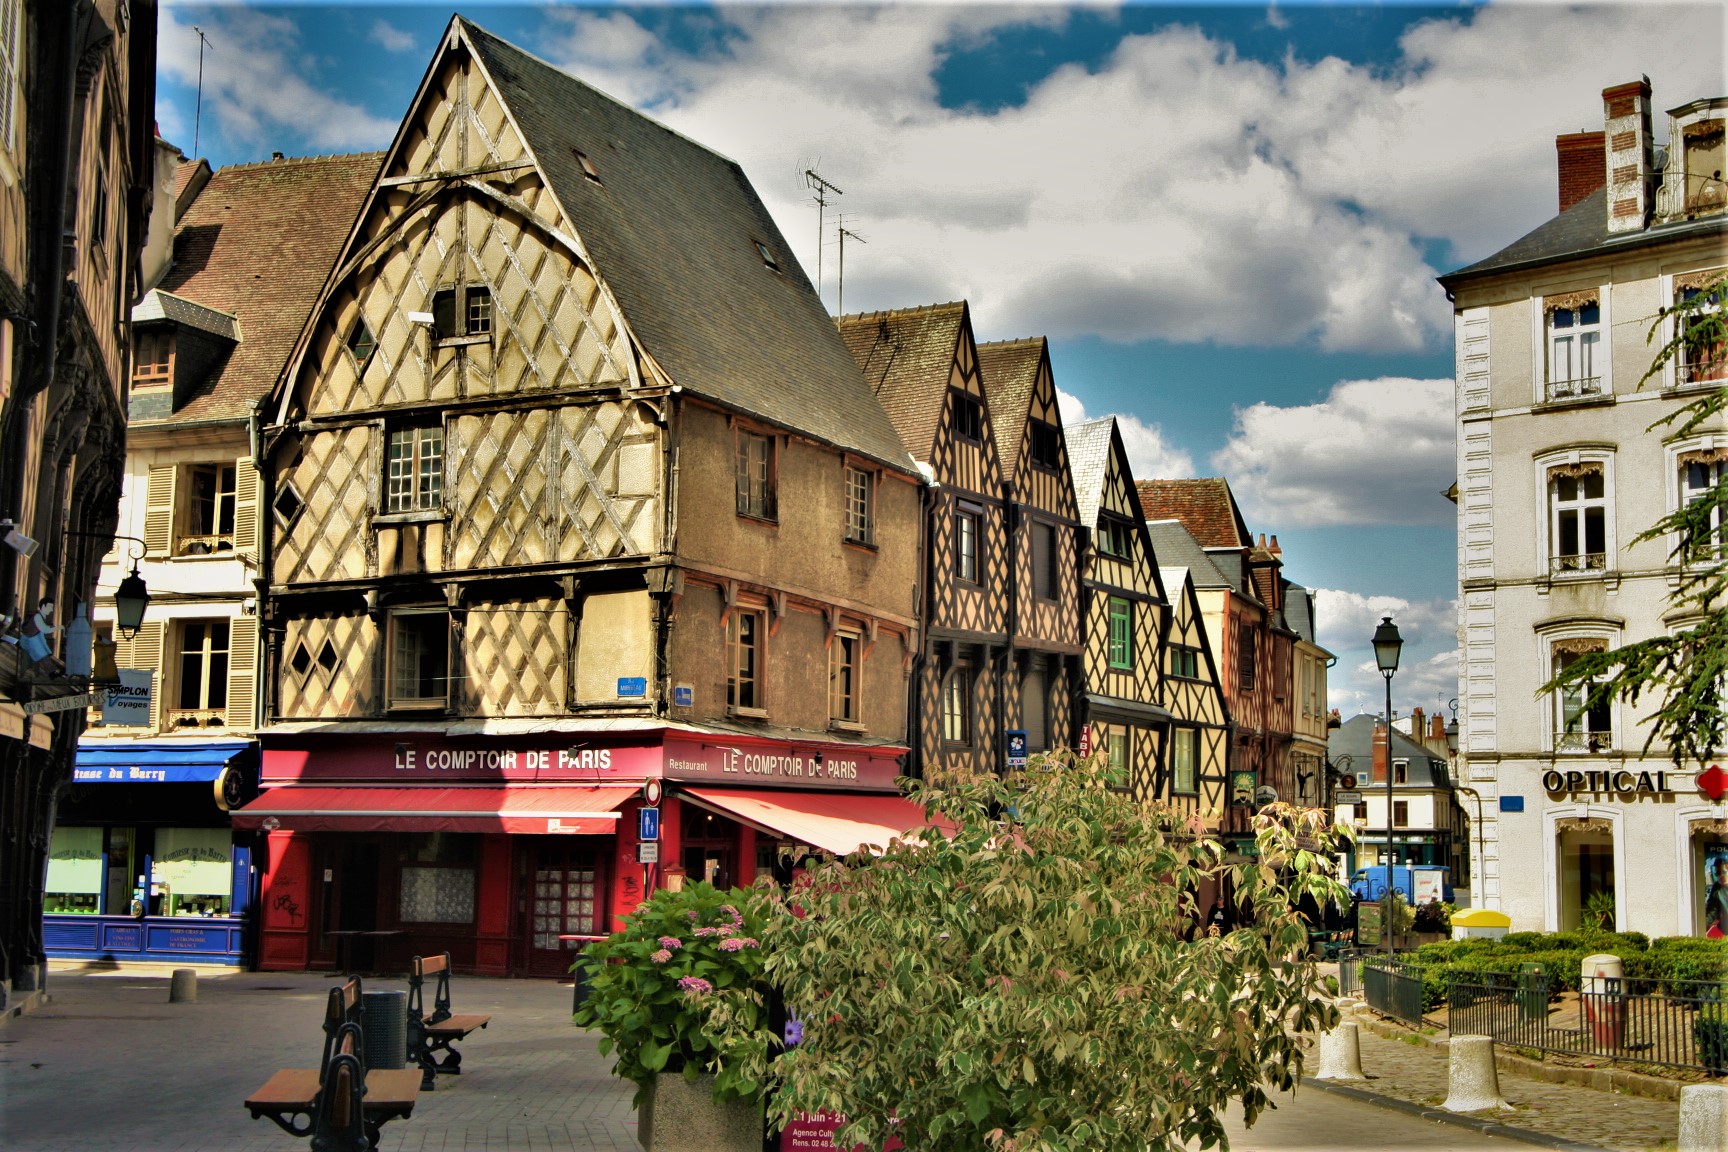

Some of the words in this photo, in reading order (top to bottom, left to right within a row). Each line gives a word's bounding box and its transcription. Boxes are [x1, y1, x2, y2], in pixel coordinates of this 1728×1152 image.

[395, 750, 416, 770] LE
[425, 749, 518, 771] COMPTOIR
[526, 750, 550, 770] DE
[558, 749, 611, 771] PARIS
[669, 758, 708, 772] Restaurant
[723, 752, 738, 772] LE
[744, 754, 803, 777] COMPTOIR
[808, 757, 823, 778] DE
[828, 760, 857, 780] PARIS
[74, 768, 103, 779] tesse
[108, 767, 123, 779] du
[129, 766, 166, 781] Barry
[1543, 770, 1672, 793] OPTICAL
[807, 1111, 826, 1124] juin
[835, 1113, 846, 1123] 21
[792, 1128, 817, 1139] Agence
[792, 1138, 810, 1147] Rens.
[811, 1139, 819, 1147] 02
[820, 1139, 829, 1147] 48
